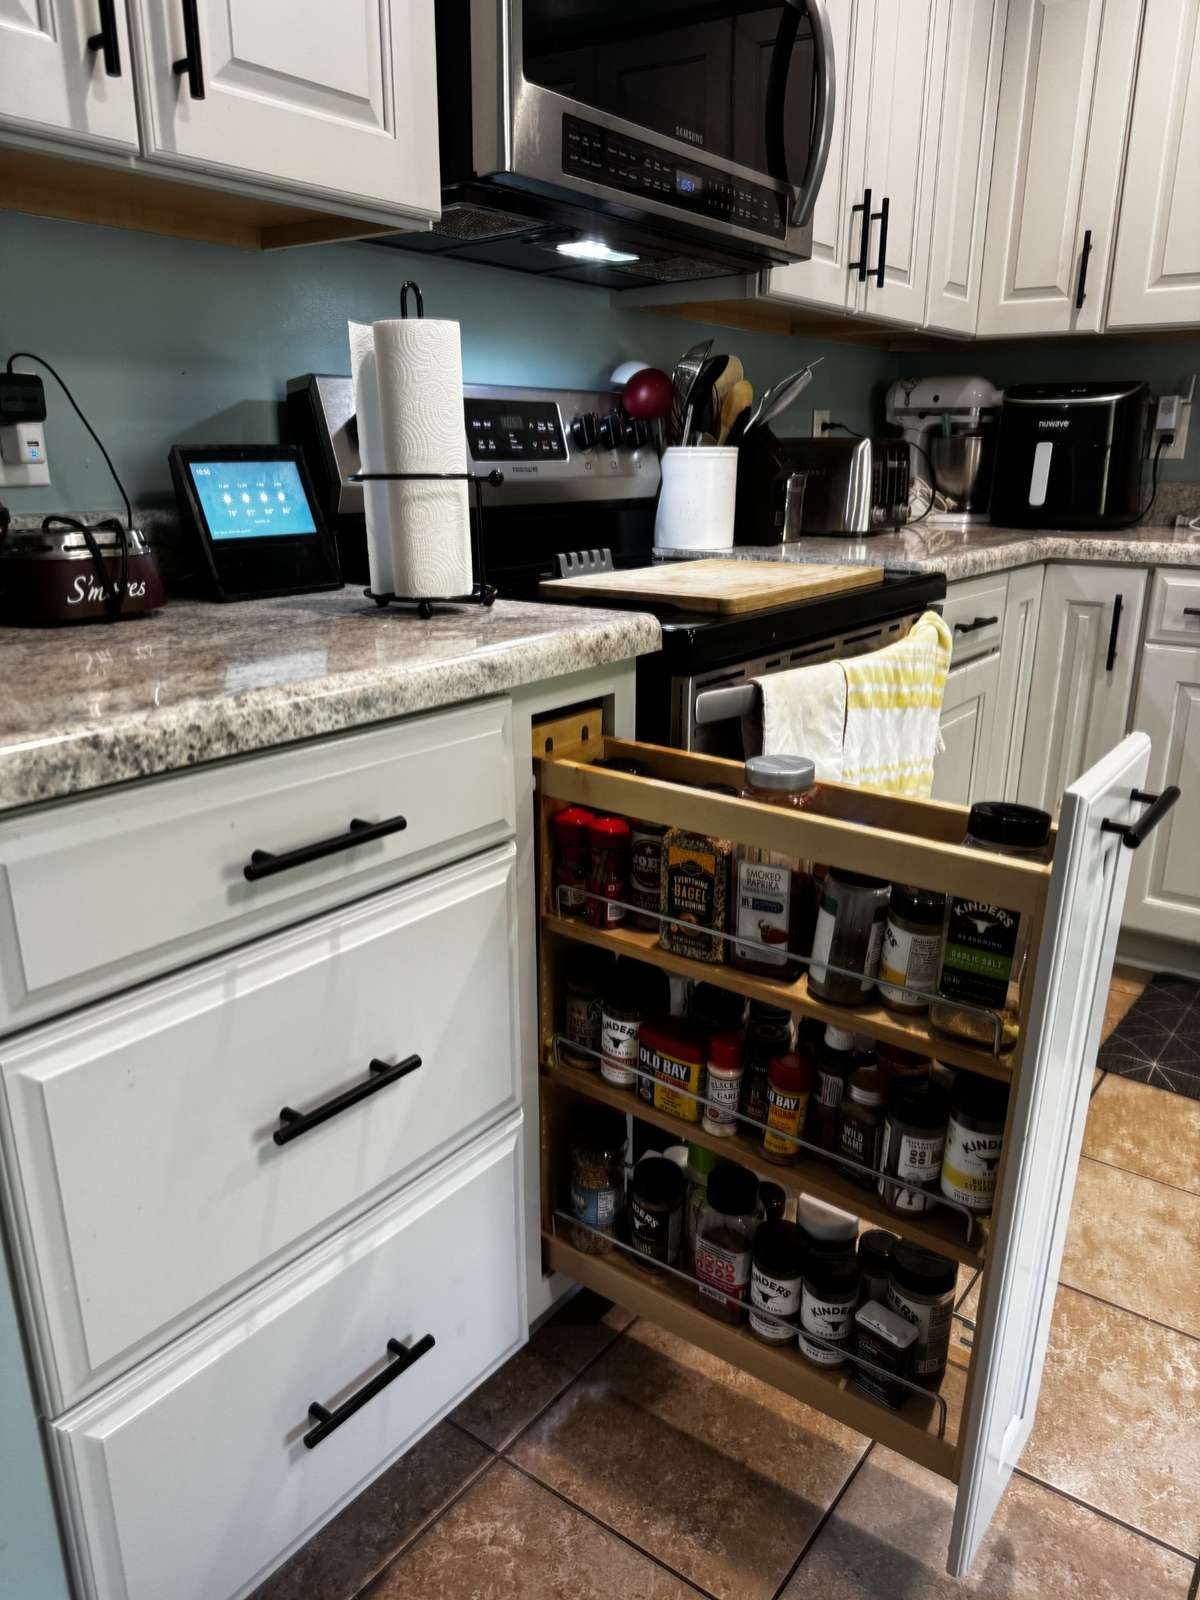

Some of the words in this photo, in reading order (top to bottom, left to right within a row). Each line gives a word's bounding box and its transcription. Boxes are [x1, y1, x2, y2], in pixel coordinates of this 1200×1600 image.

[675, 125, 704, 145] SAMSUNG
[1038, 420, 1070, 428] nuwave
[67, 575, 146, 604] S'mes
[746, 868, 782, 882] SMOKED
[673, 884, 707, 902] BAGEL
[746, 879, 780, 890] PAPRIKA
[673, 897, 706, 912] SEASONING
[640, 1047, 660, 1070] OLD
[663, 1058, 687, 1080] BAY
[776, 1095, 798, 1110] BAY
[843, 1123, 863, 1142] WILD
[841, 1133, 864, 1153] GAME
